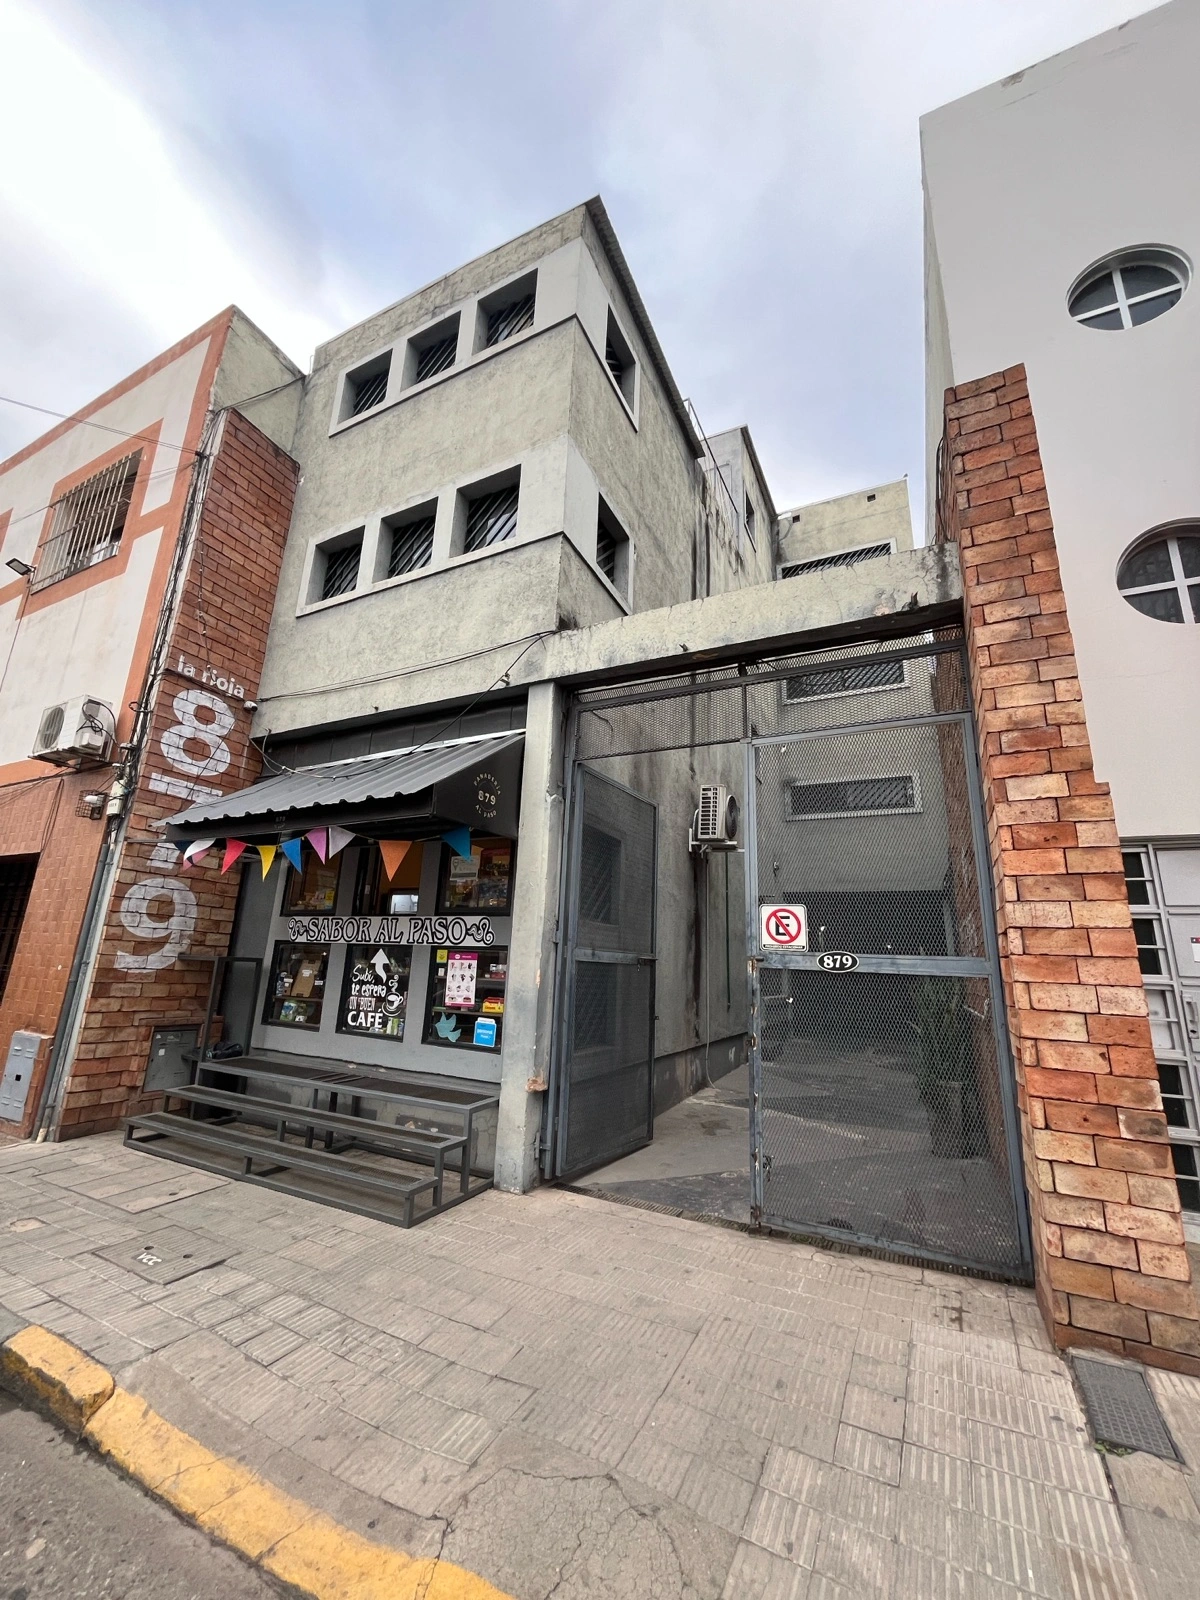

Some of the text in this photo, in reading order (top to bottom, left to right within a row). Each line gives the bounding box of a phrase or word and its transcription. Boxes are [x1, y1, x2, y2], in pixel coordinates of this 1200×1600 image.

[178, 654, 196, 678] la
[477, 790, 496, 805] 879
[483, 810, 497, 818] PASO
[306, 917, 469, 945] SABOR AL PASO
[823, 955, 852, 968] 879
[347, 1008, 384, 1029] CAFÉ
